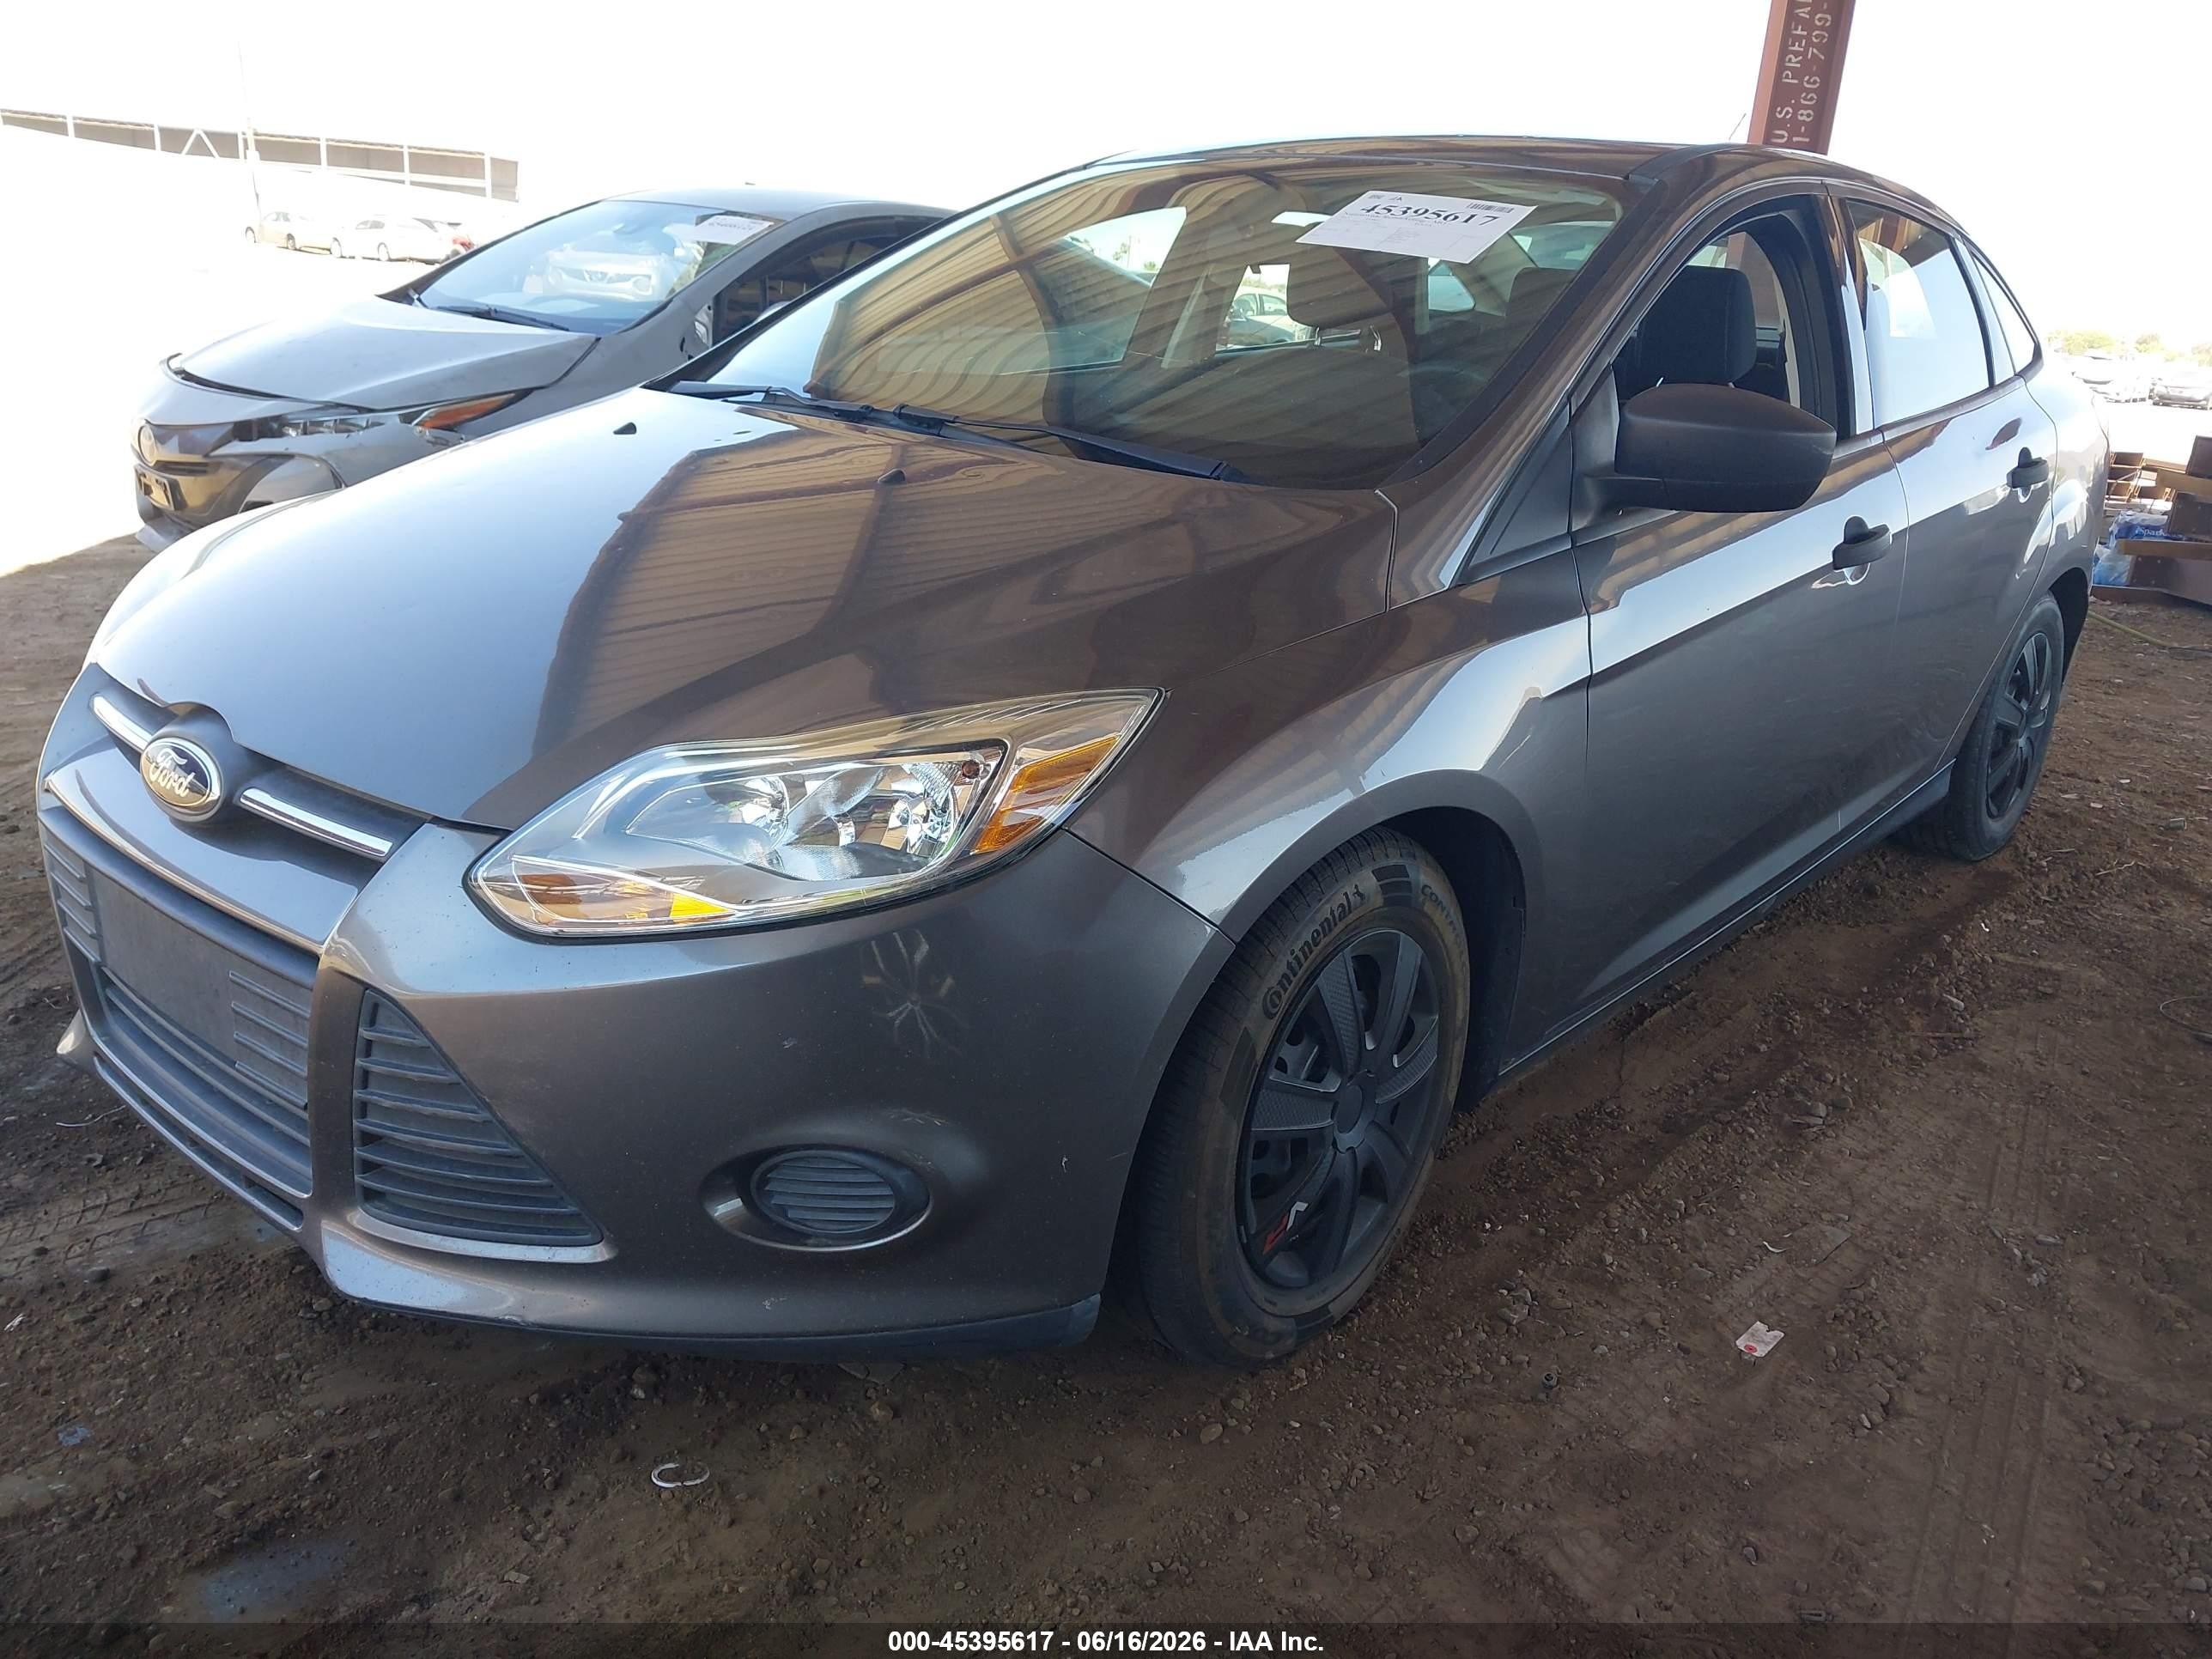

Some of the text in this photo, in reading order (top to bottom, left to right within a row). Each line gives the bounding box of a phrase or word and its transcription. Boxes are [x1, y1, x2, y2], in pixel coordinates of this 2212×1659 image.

[1771, 99, 1796, 143] U.S.
[1359, 204, 1501, 226] 45395617
[149, 747, 196, 798] Ford
[1261, 891, 1353, 1021] Continental
